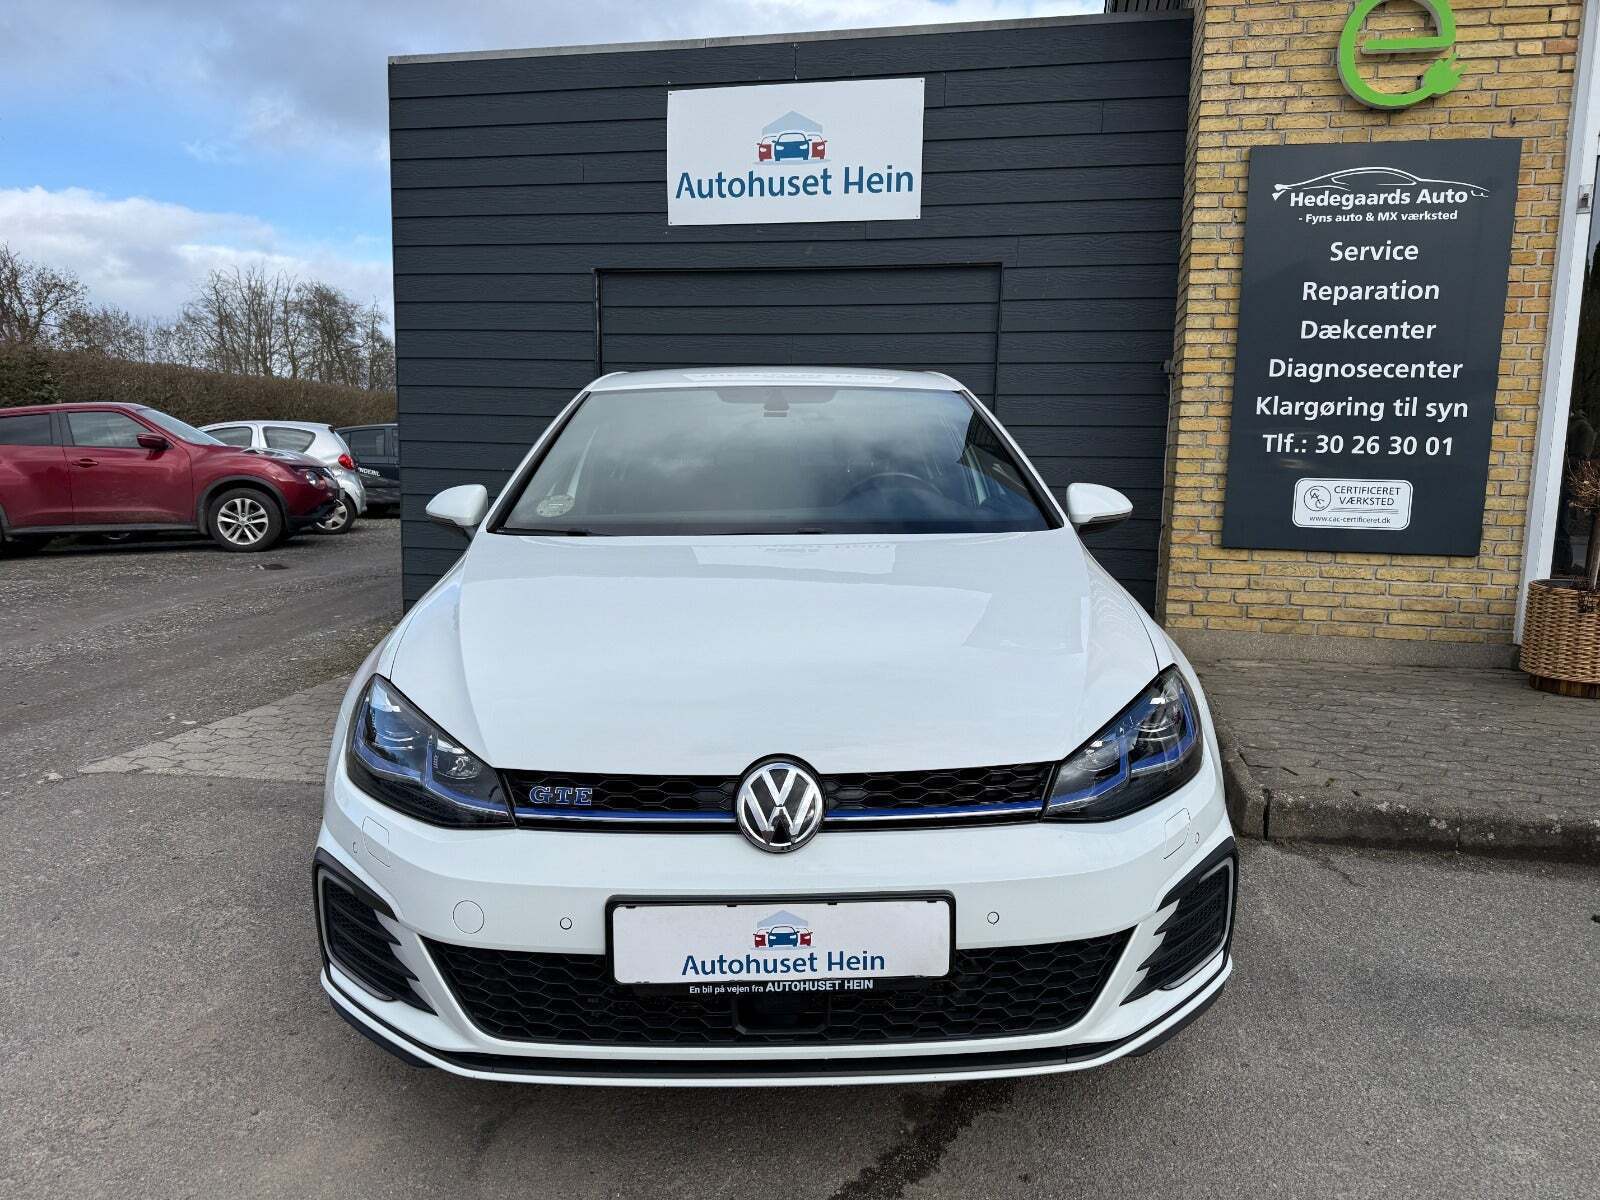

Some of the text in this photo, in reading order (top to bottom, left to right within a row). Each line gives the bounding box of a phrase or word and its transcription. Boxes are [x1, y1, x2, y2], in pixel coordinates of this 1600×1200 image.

[675, 164, 914, 199] Autohuset Hein
[1289, 188, 1468, 210] Hedegaards Auto
[1305, 213, 1332, 225] Fyns
[1335, 212, 1362, 222] auto
[1365, 213, 1374, 222] &
[1377, 211, 1398, 221] MX
[1401, 210, 1458, 221] værksted
[1330, 240, 1419, 261] Service
[1302, 280, 1440, 305] Reparation
[1300, 319, 1437, 340] Dækcenter
[1268, 358, 1464, 382] Diagnosecenter
[1256, 396, 1468, 422] Klargøring til syn
[1262, 433, 1453, 456] Tlf.: 30 26 30 01
[1334, 485, 1401, 496] CERTIFICERET
[1339, 496, 1394, 506] VÆRKSTED
[1309, 516, 1391, 524] www.cac-certificeret.dk
[529, 786, 593, 806] GTE
[681, 950, 885, 976] Autohuset Hein
[689, 979, 874, 995] En bil på vejen fra AUTOHUSET HEIN
